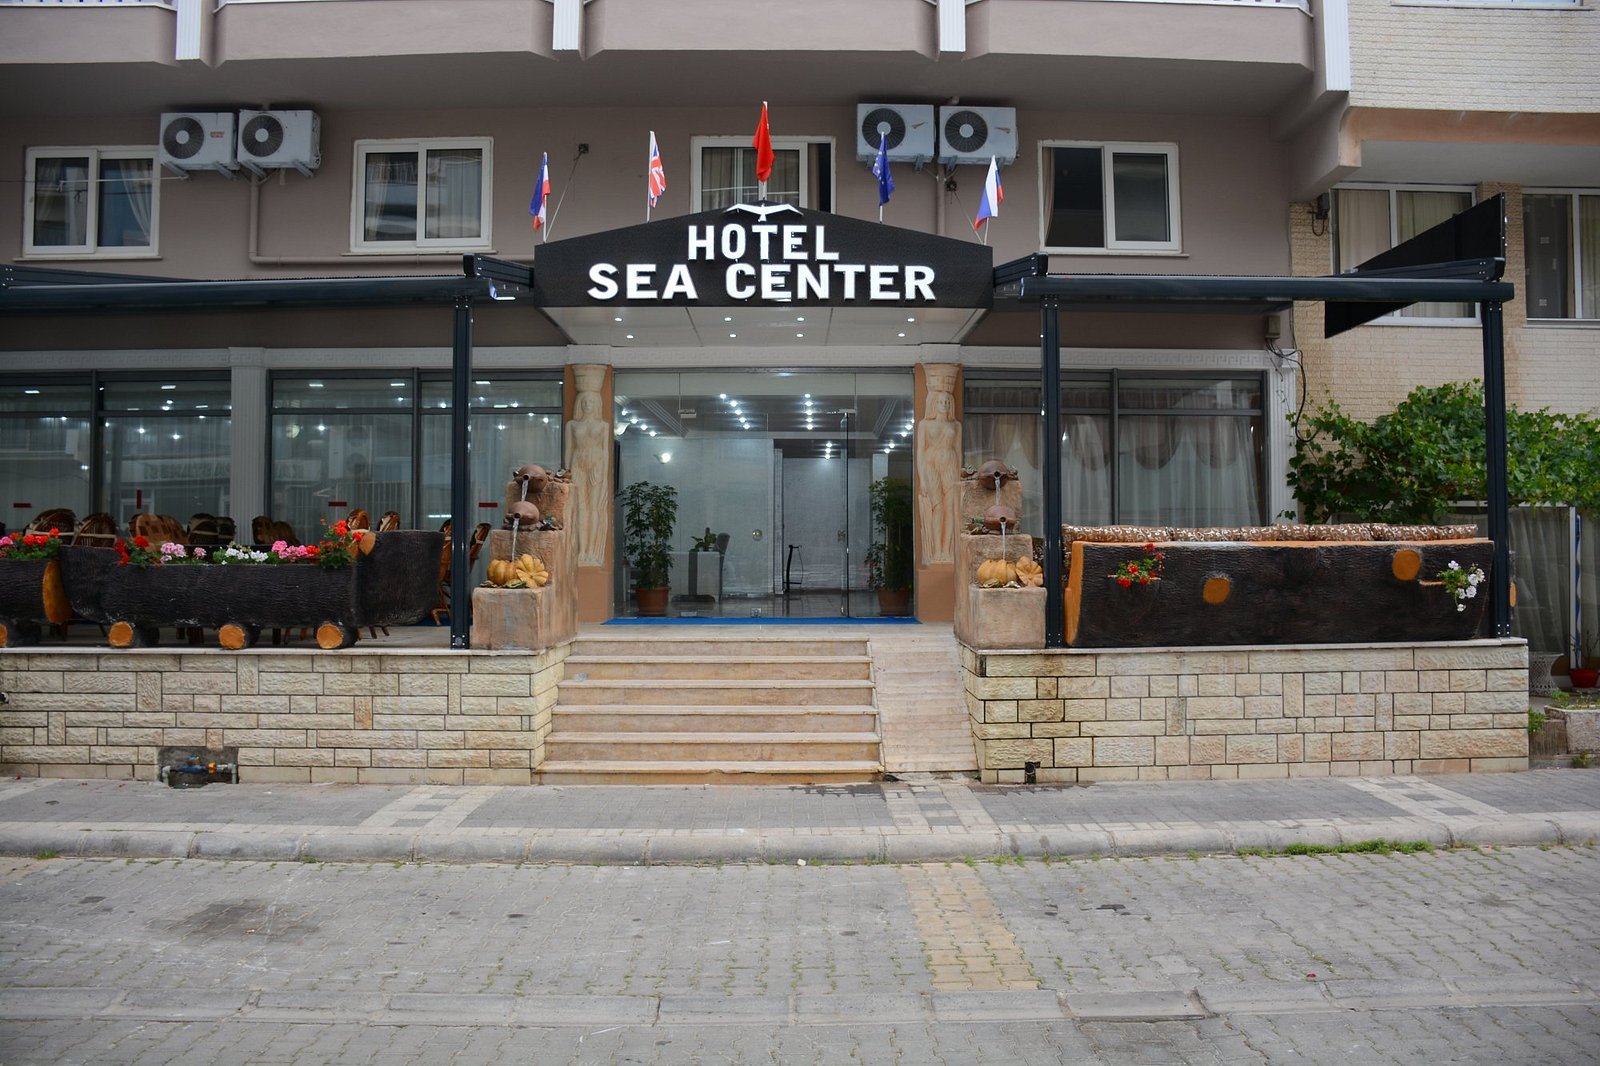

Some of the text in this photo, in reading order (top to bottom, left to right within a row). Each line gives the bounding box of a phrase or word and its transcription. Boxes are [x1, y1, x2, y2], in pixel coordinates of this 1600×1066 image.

[687, 223, 839, 261] HOTEL
[587, 263, 936, 301] SEA CENTER
